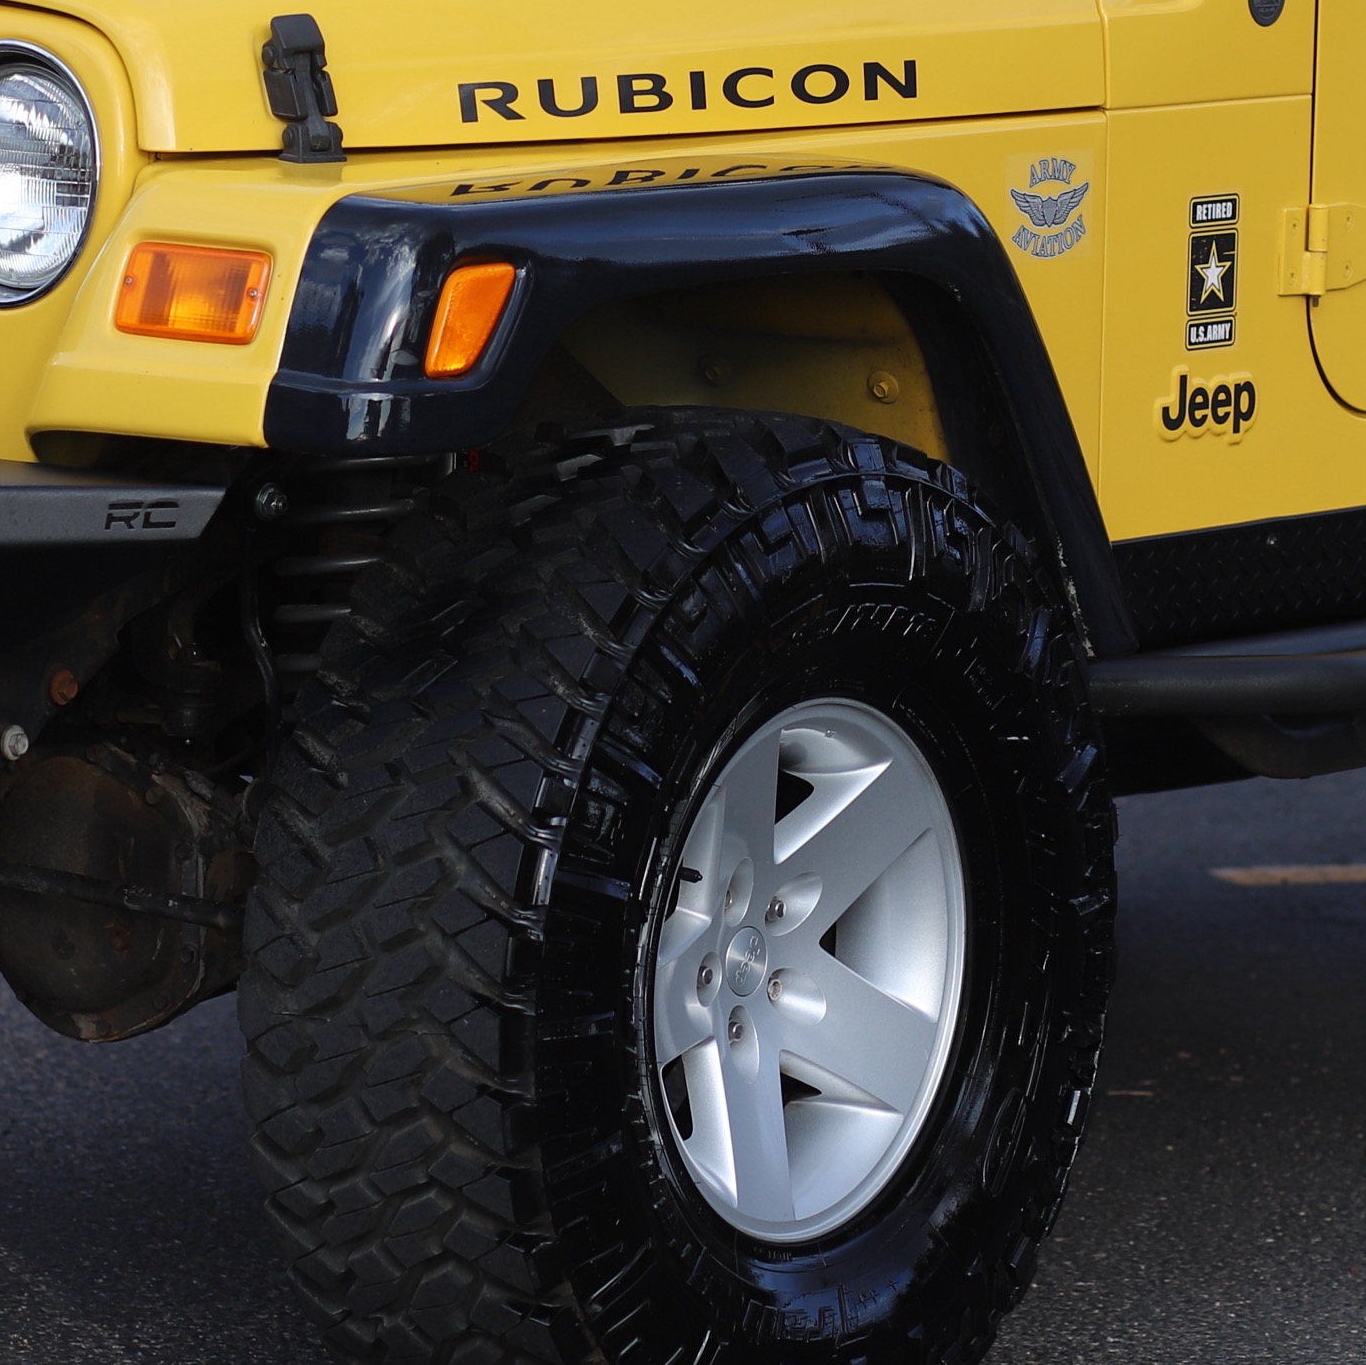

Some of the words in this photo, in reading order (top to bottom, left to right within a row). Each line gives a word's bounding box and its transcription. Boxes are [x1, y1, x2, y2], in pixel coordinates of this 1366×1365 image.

[457, 59, 918, 122] RUBICON
[1029, 157, 1076, 188] ARMY
[1196, 201, 1233, 221] RETIRED
[1012, 213, 1087, 258] AVIATION
[1161, 374, 1256, 434] Jeep
[104, 499, 180, 530] RC
